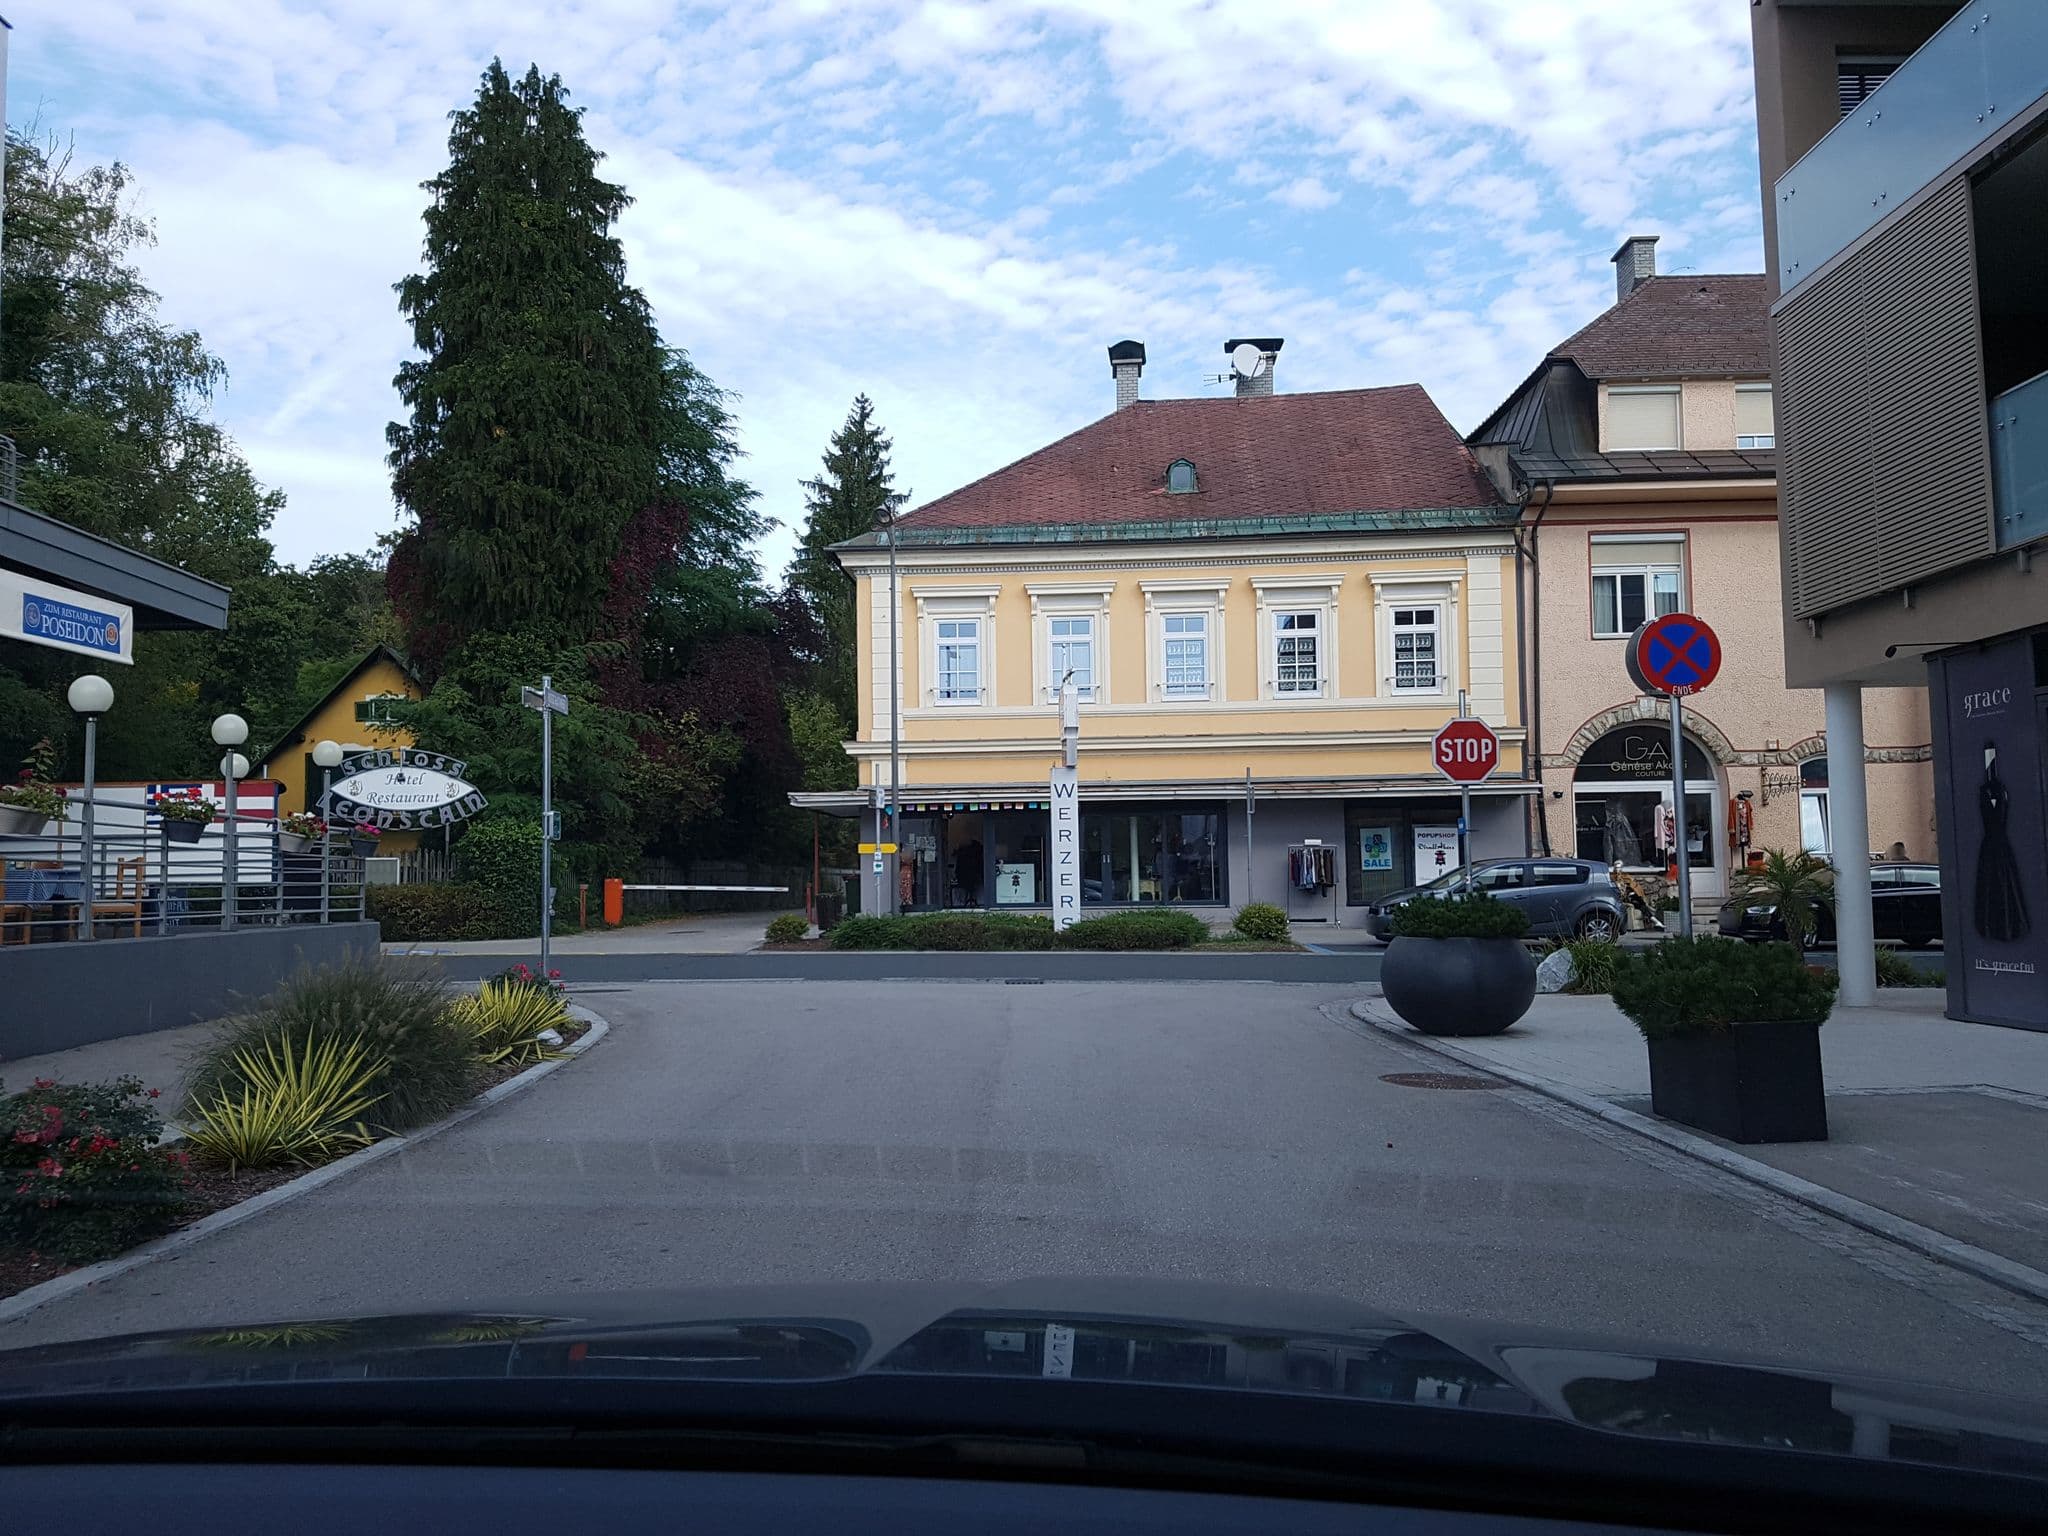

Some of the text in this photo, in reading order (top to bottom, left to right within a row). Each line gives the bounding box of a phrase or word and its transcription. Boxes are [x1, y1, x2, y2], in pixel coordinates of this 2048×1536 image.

[43, 603, 102, 624] ZUM RESTAURANT
[41, 615, 104, 646] POSEIDON
[1672, 684, 1695, 695] ENDE
[1964, 687, 2011, 718] grace
[1441, 738, 1492, 763] STOP
[1625, 736, 1669, 760] GA
[366, 792, 439, 805] Restaurant
[1053, 783, 1075, 931] WERZERS
[1363, 859, 1392, 868] SALE
